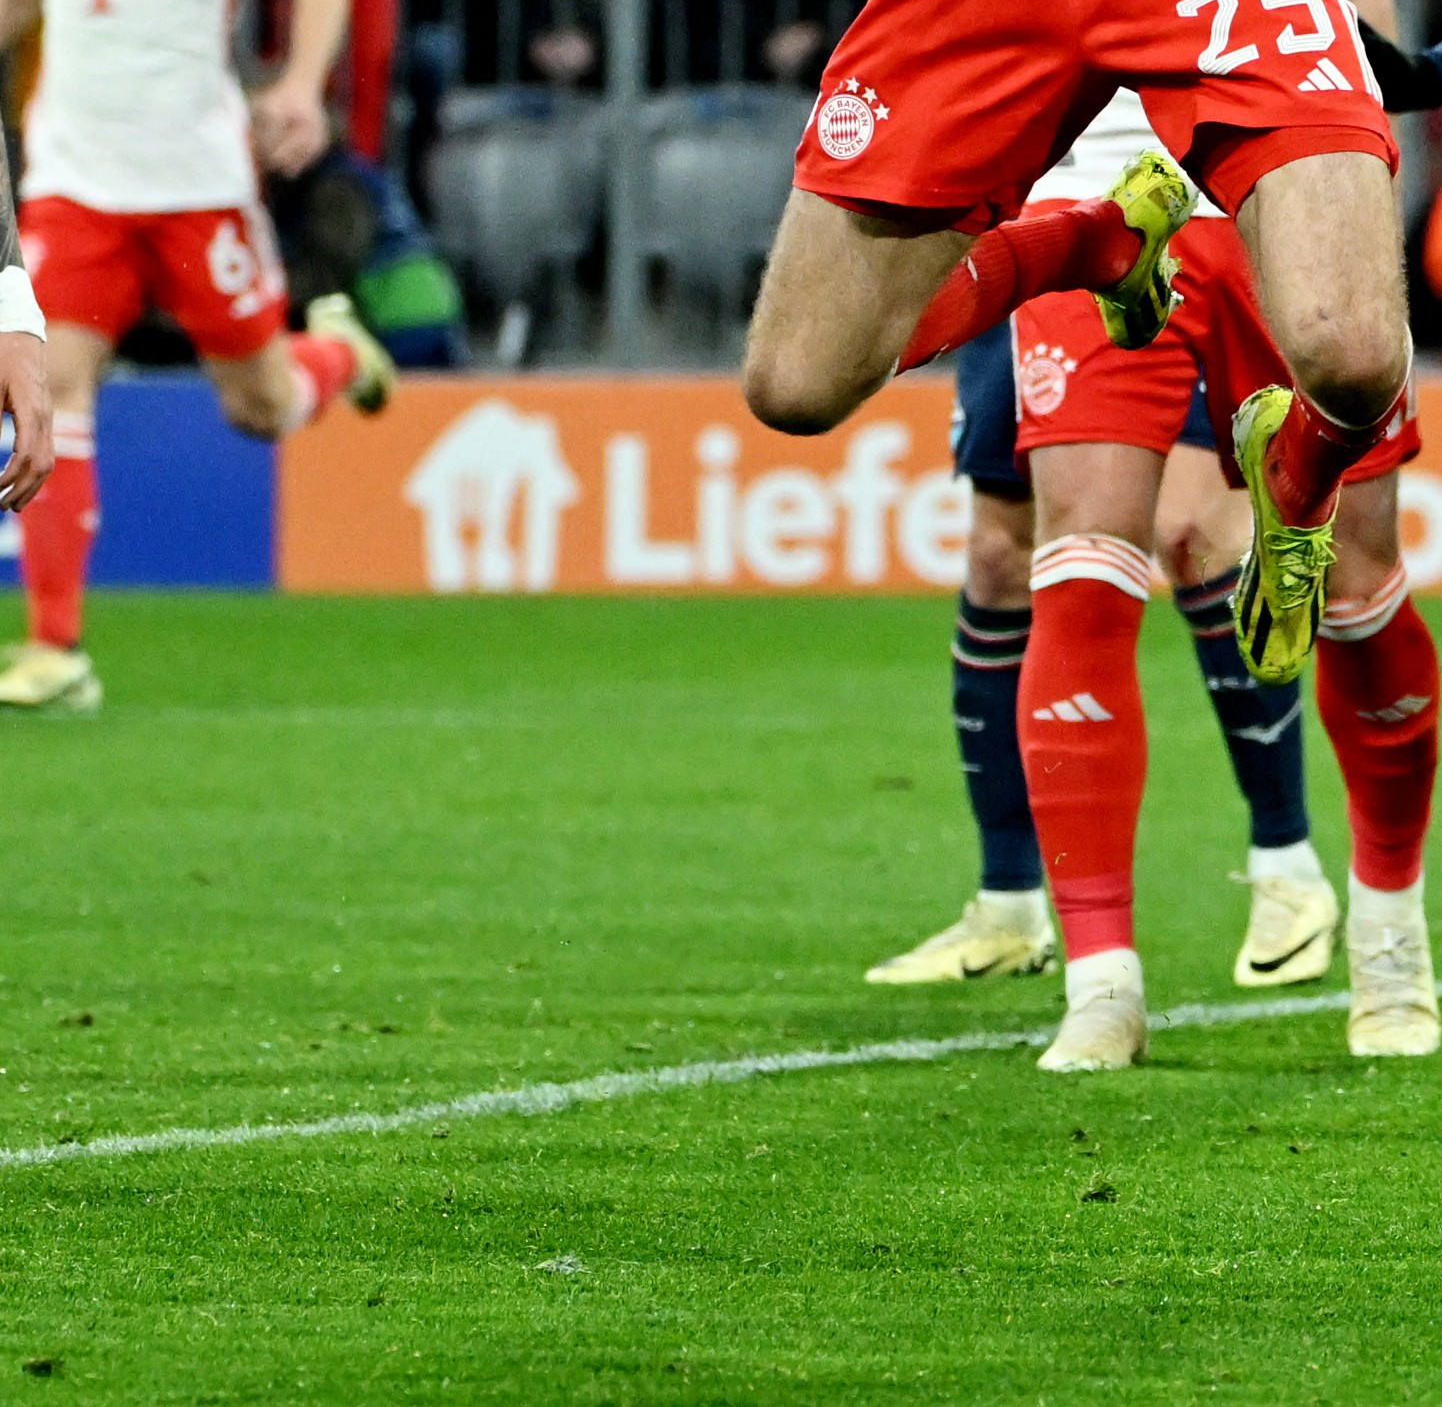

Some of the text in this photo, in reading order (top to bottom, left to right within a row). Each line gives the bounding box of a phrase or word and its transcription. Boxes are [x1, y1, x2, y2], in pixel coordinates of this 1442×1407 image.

[823, 99, 869, 127] FC BAYERN
[207, 216, 257, 294] 6
